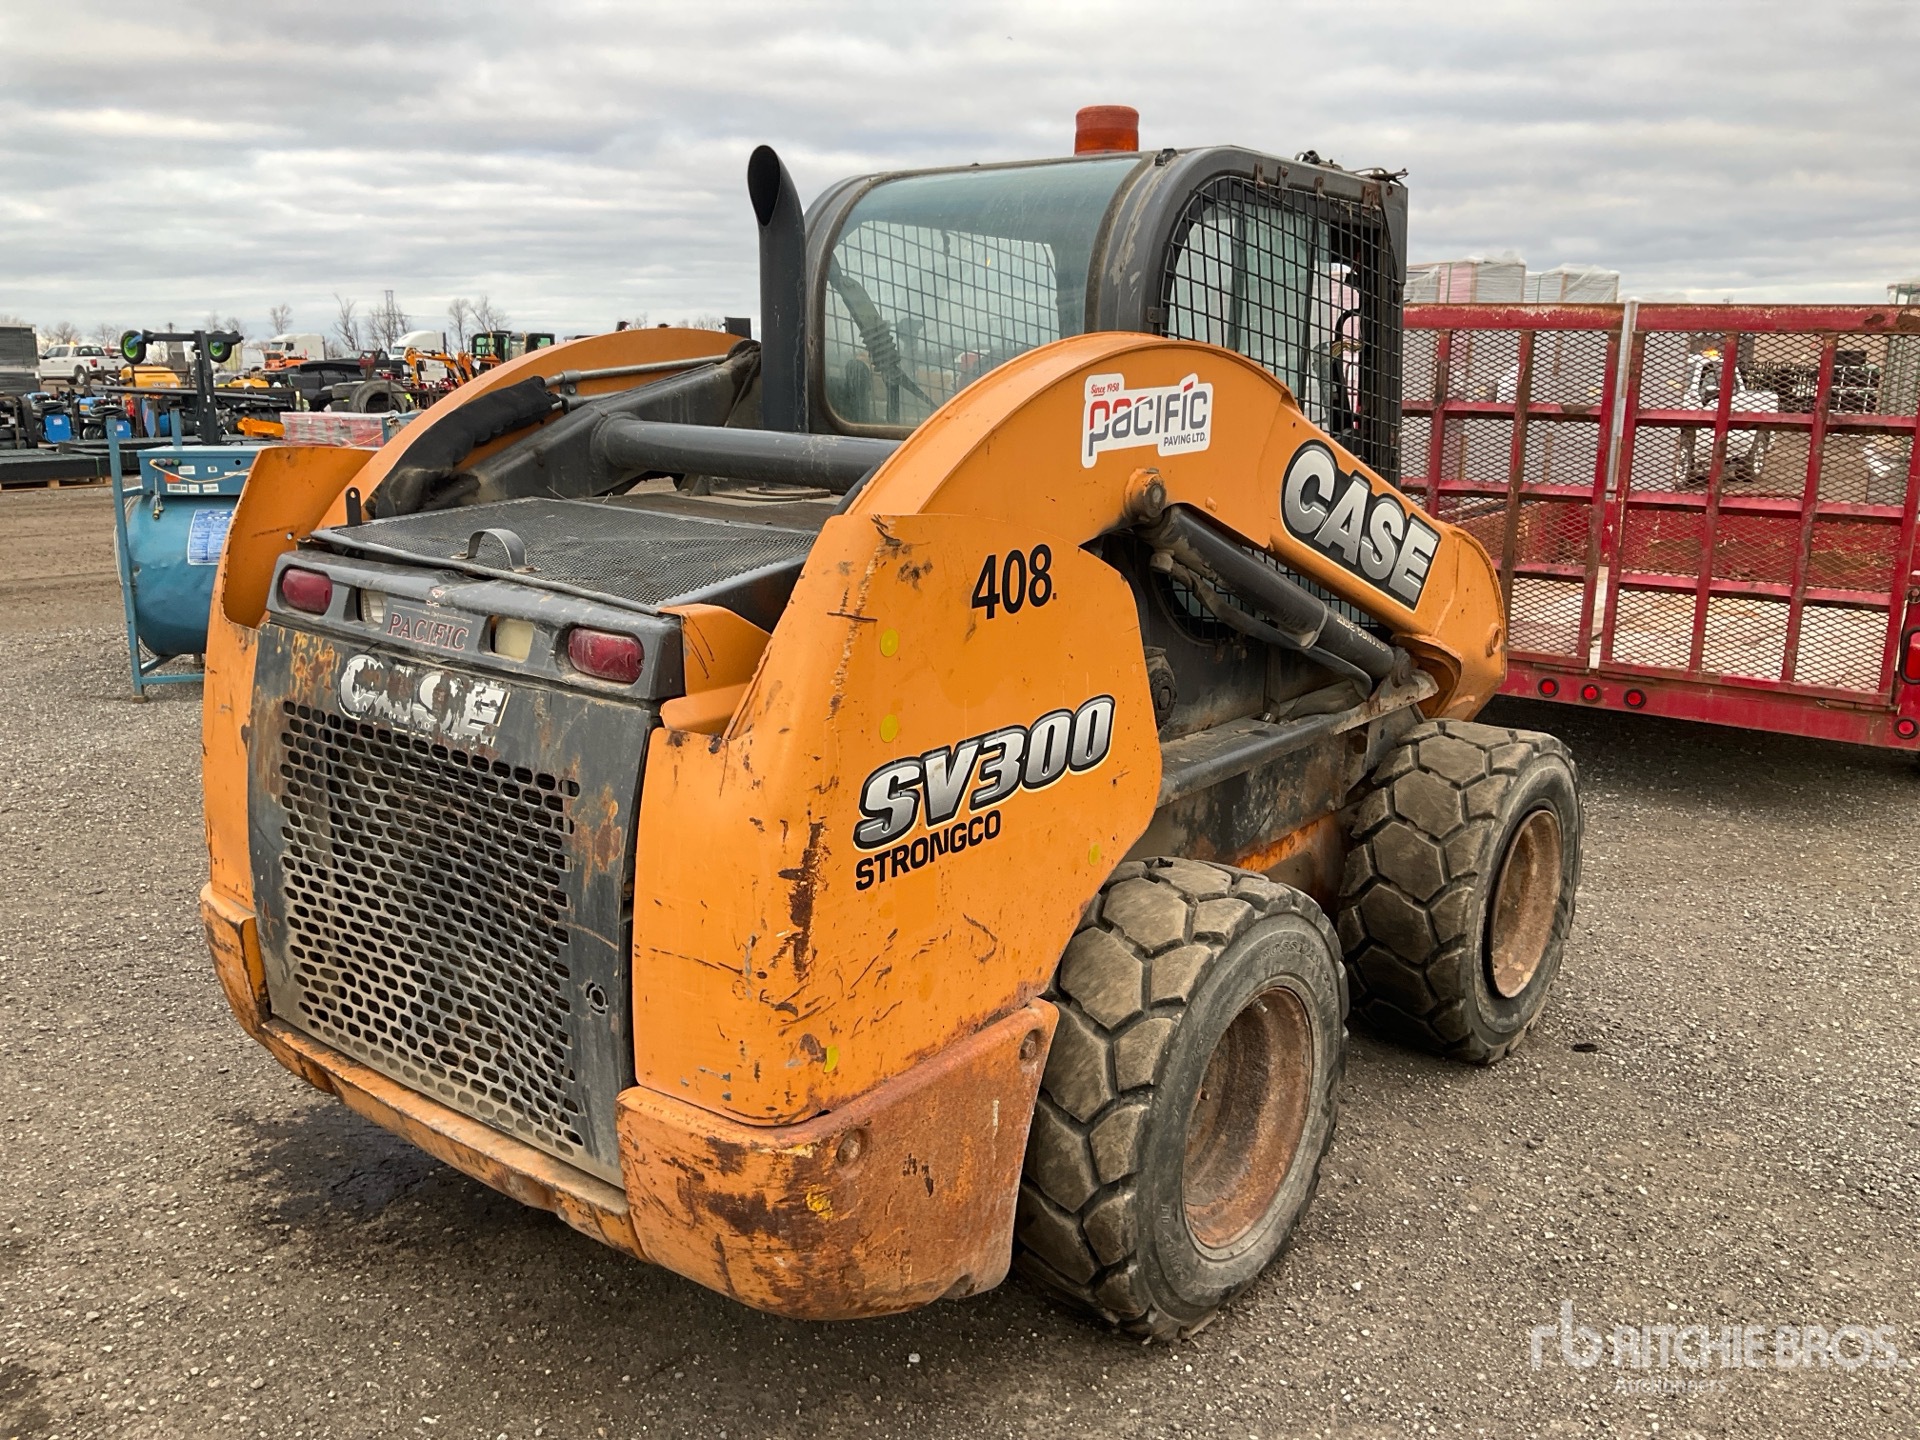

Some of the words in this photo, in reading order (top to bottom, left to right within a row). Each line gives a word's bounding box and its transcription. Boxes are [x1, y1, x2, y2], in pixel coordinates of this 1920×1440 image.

[1091, 384, 1106, 396] Since
[1163, 434, 1191, 447] PAVING
[1191, 431, 1207, 443] LTD.
[1283, 444, 1440, 605] CASE
[386, 611, 470, 652] PACIFIC
[854, 695, 1115, 848] SV300
[855, 809, 1001, 892] STRONGCO
